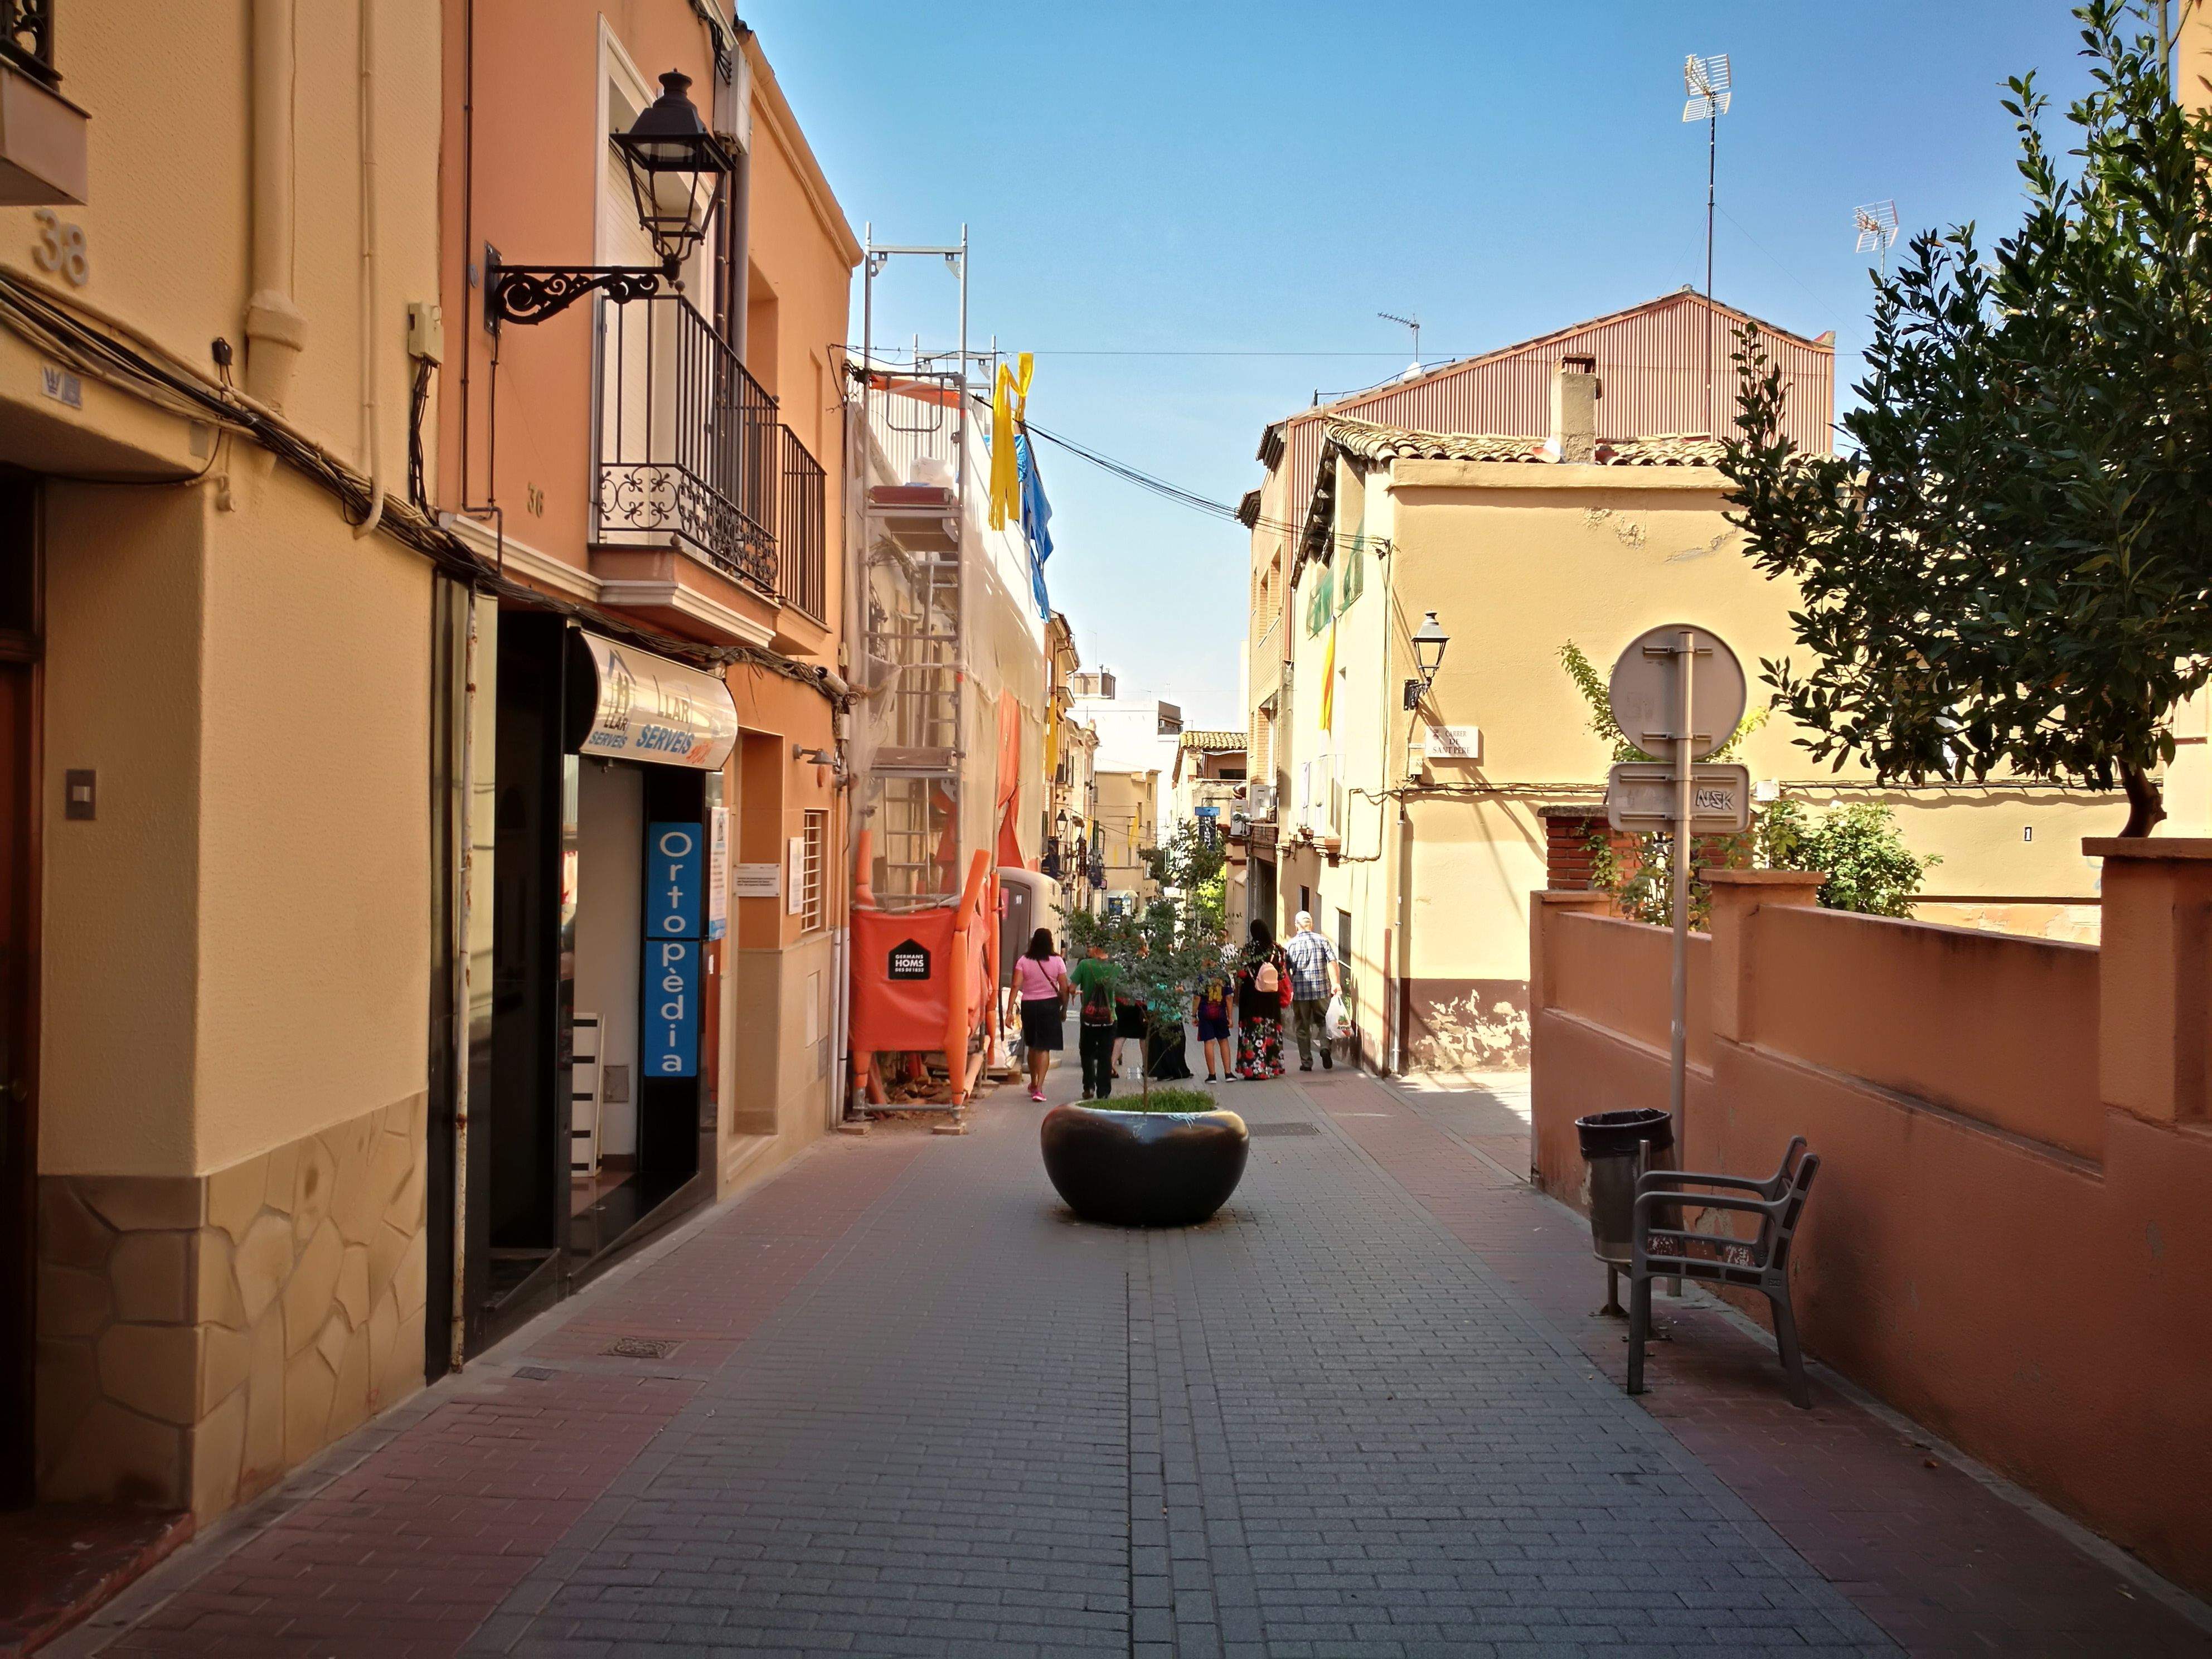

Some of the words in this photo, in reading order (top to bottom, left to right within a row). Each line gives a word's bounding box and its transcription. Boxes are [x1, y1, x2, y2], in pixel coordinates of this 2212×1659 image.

[33, 207, 90, 285] 38
[527, 483, 545, 518] 36
[589, 731, 628, 749] SERVEIS
[636, 724, 695, 754] SERVEIS
[2025, 828, 2031, 841] 1
[659, 831, 692, 1073] Ortopèdia
